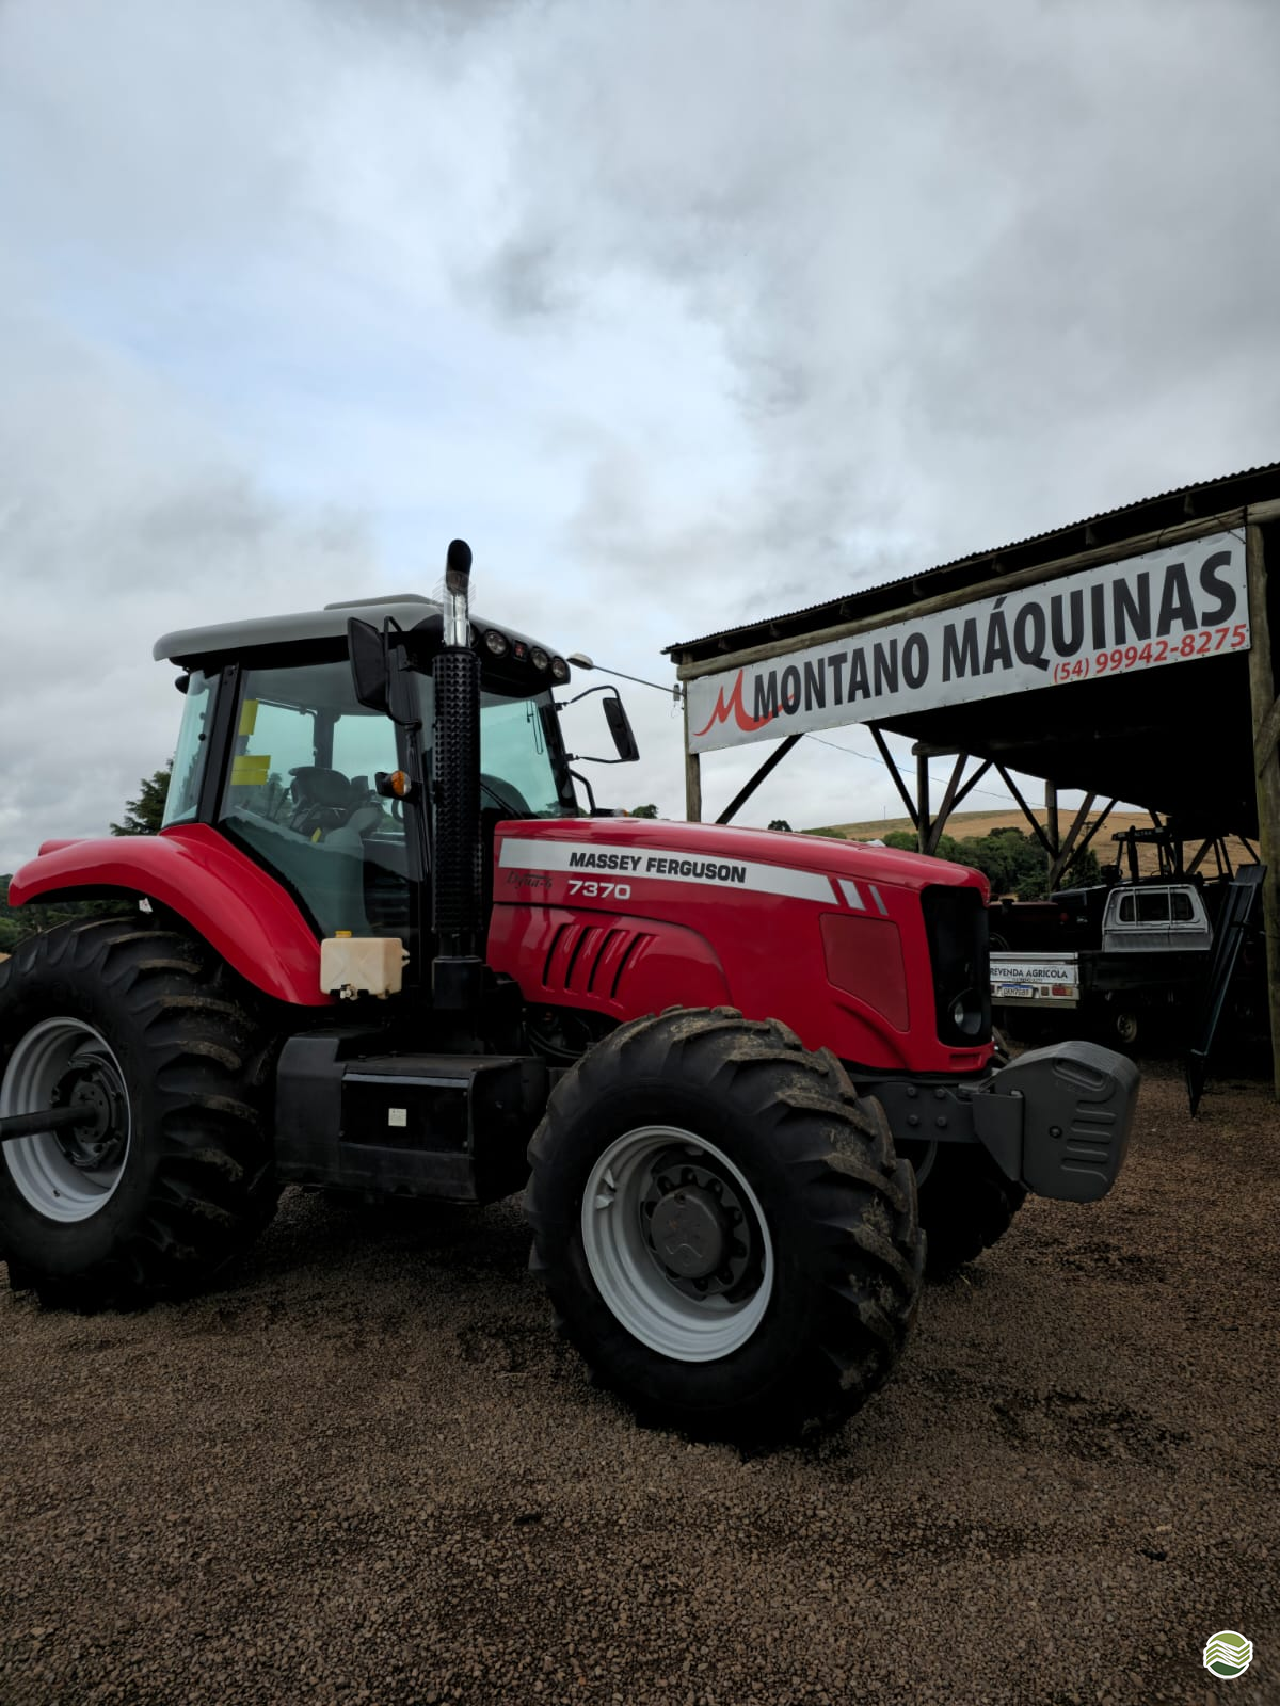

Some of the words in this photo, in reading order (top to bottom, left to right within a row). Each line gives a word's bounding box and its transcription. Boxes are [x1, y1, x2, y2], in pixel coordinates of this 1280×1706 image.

[752, 632, 930, 723] MONTANO
[941, 550, 1237, 682] MÁQUINAS
[1053, 656, 1090, 683] (54)
[1095, 623, 1248, 674] 99942-8275
[567, 879, 632, 901] 7370
[569, 852, 642, 872] MASSEY
[645, 857, 747, 884] FERGUSON
